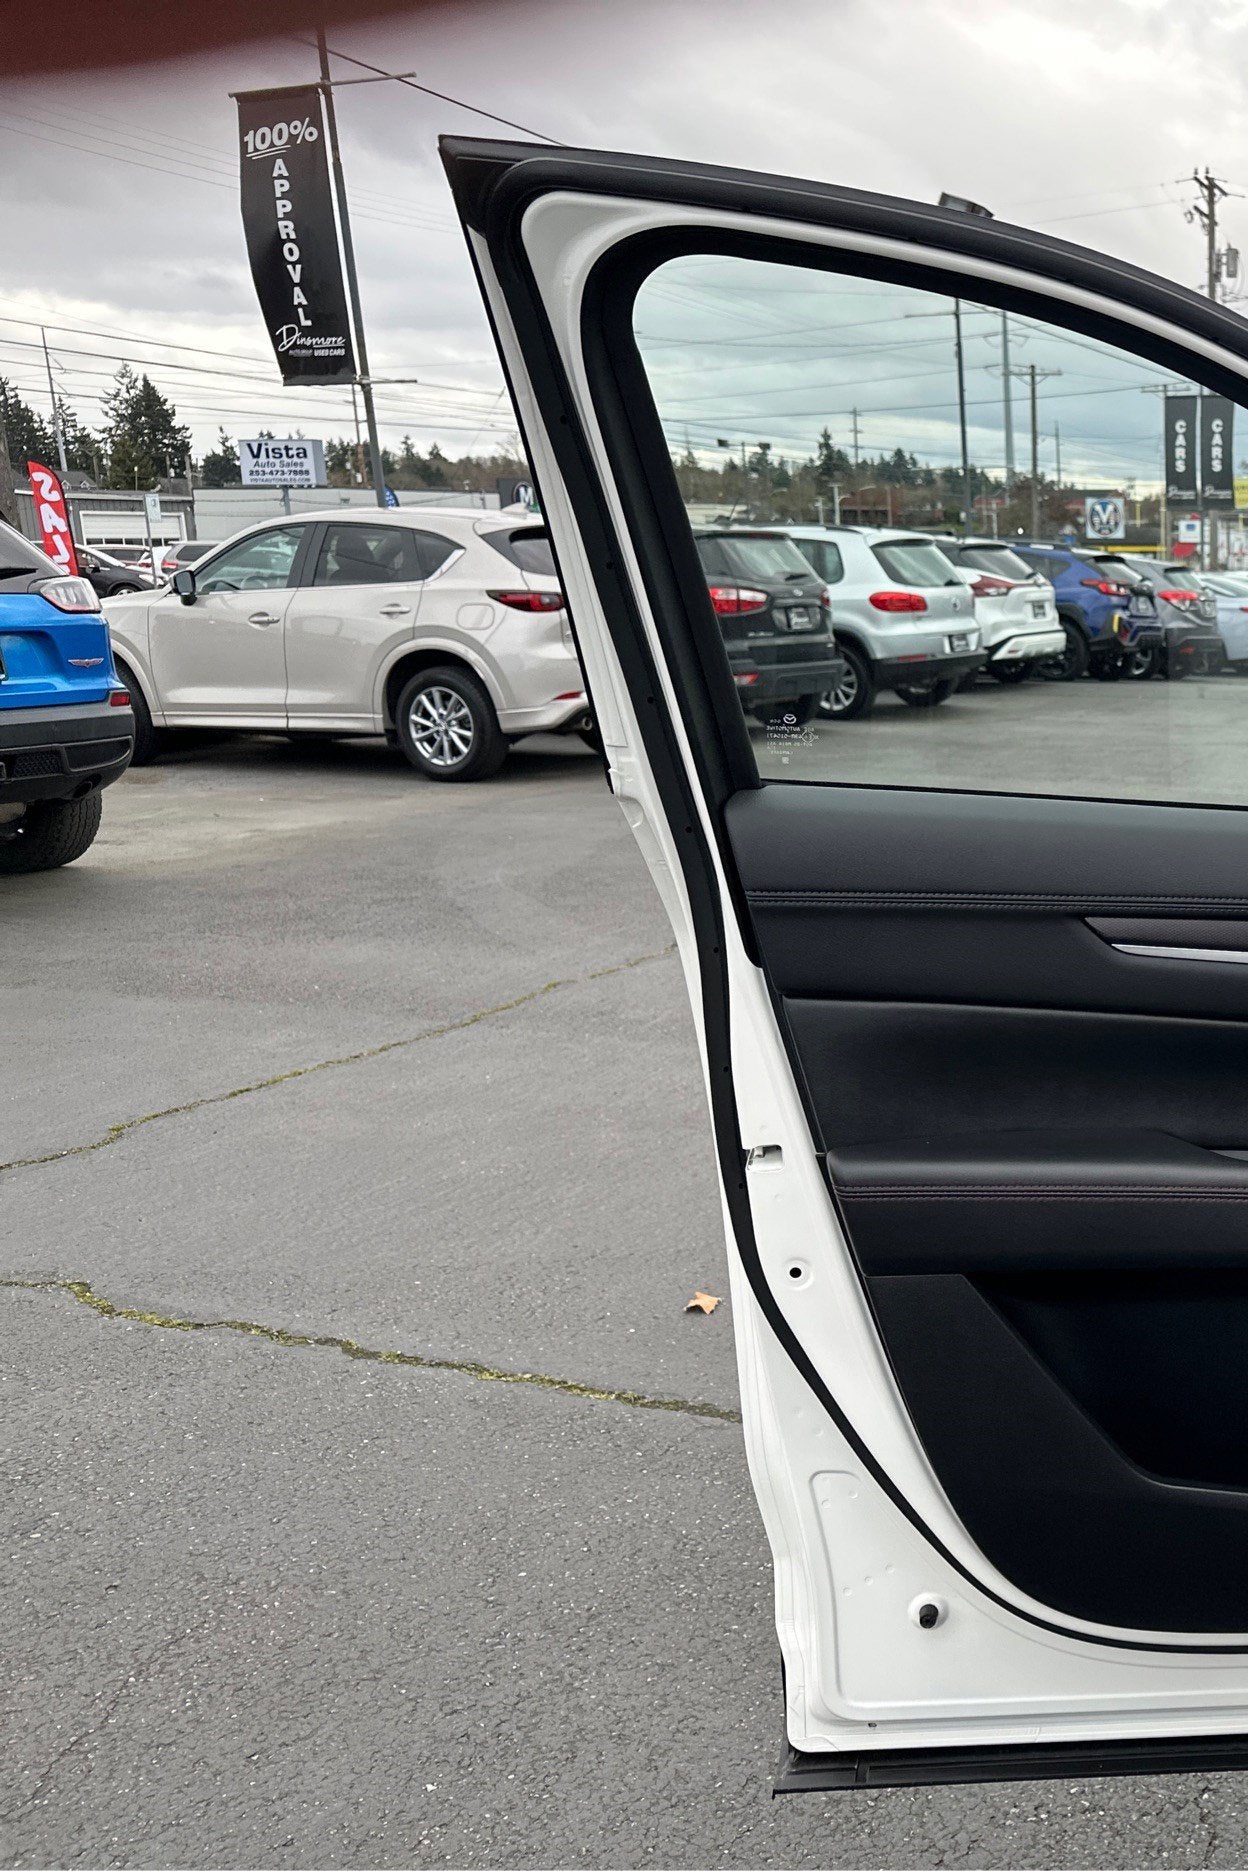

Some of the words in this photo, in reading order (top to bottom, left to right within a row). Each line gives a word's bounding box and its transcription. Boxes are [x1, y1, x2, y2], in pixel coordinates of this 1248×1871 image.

[244, 117, 318, 154] 100%
[271, 158, 313, 327] APPROVAL
[275, 323, 346, 352] Dinsmore
[313, 348, 329, 357] USED
[330, 348, 346, 356] CARS
[246, 442, 308, 459] Vista
[1174, 419, 1187, 473] CARS
[1211, 418, 1224, 472] CARS
[253, 460, 276, 469] Auto
[279, 460, 304, 469] Sales
